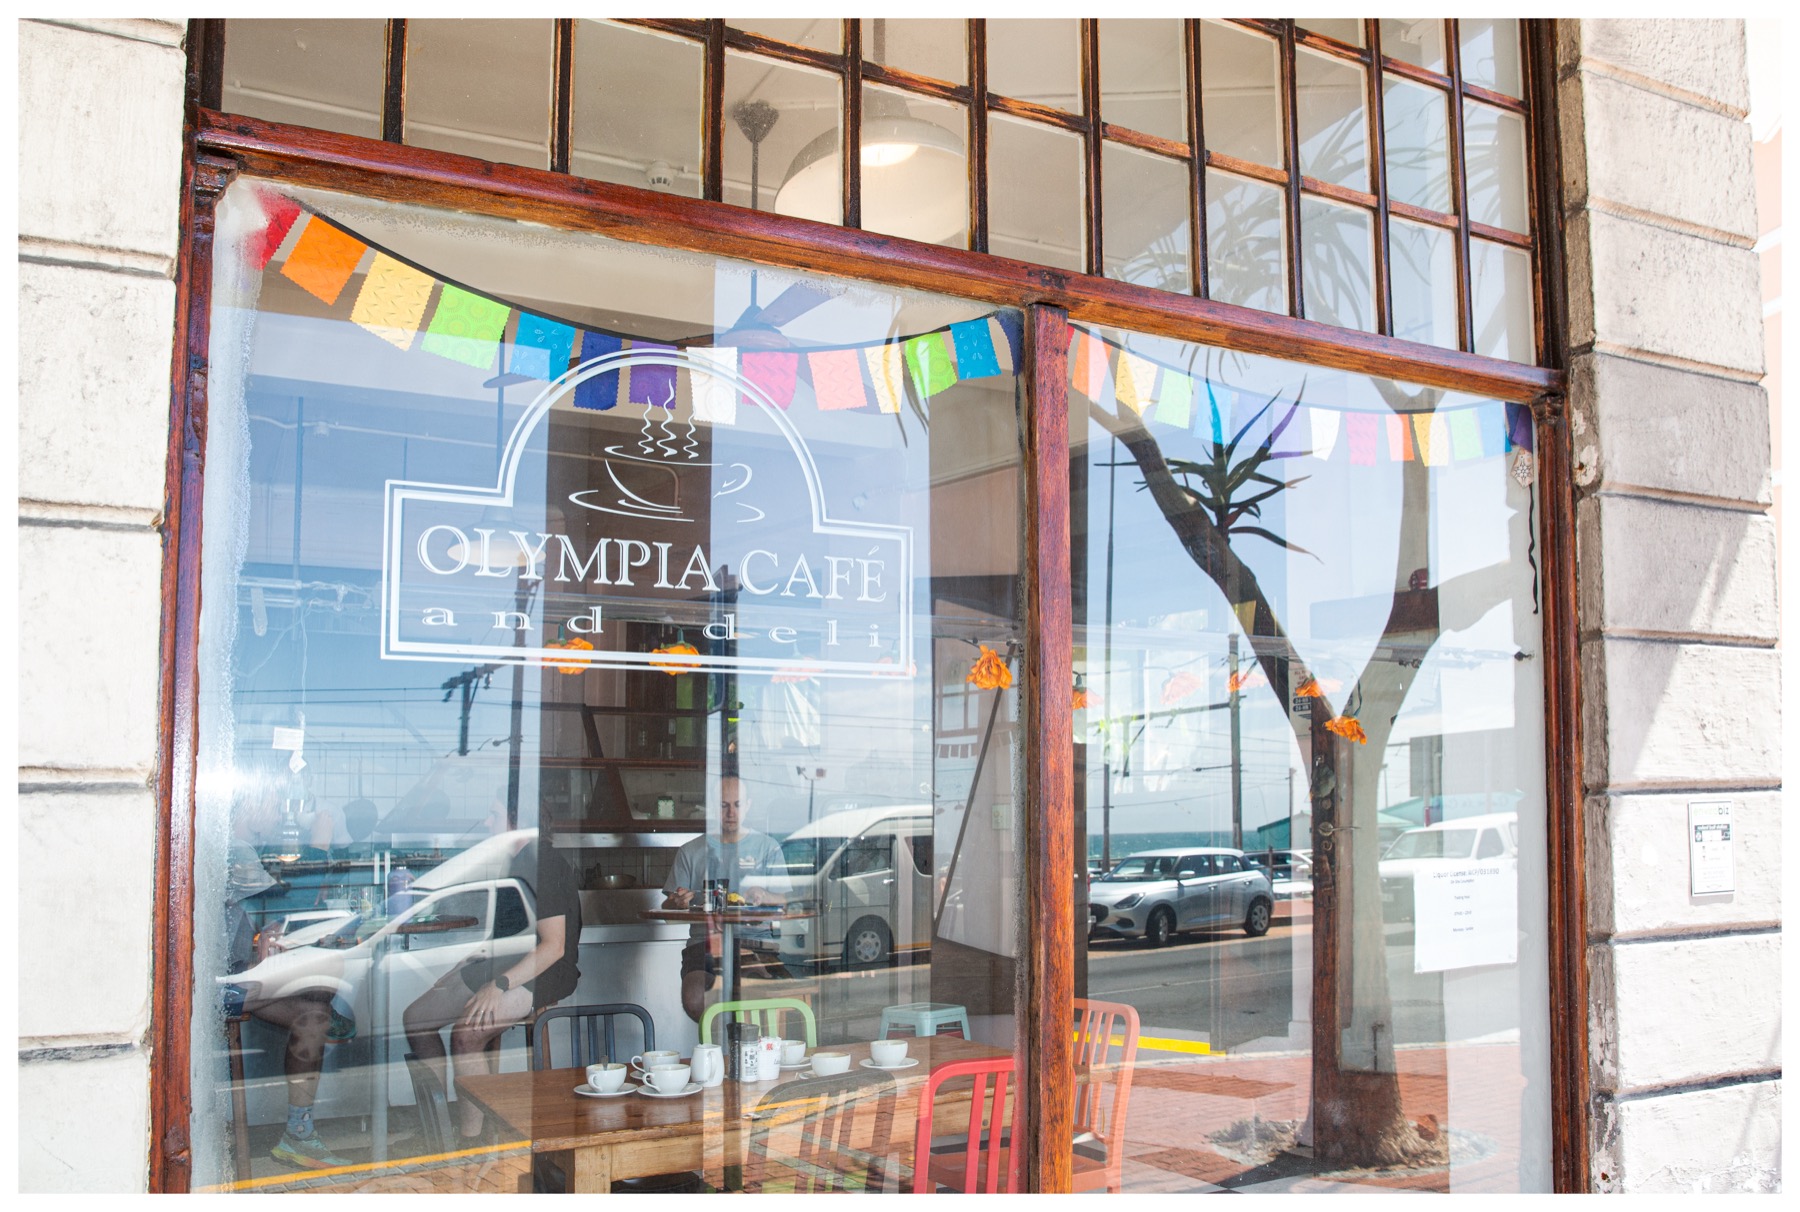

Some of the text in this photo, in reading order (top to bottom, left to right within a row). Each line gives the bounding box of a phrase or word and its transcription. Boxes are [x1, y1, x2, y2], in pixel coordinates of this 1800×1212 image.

[416, 524, 888, 603] OLYMPIA CAFÉ
[421, 604, 882, 648] and deli
